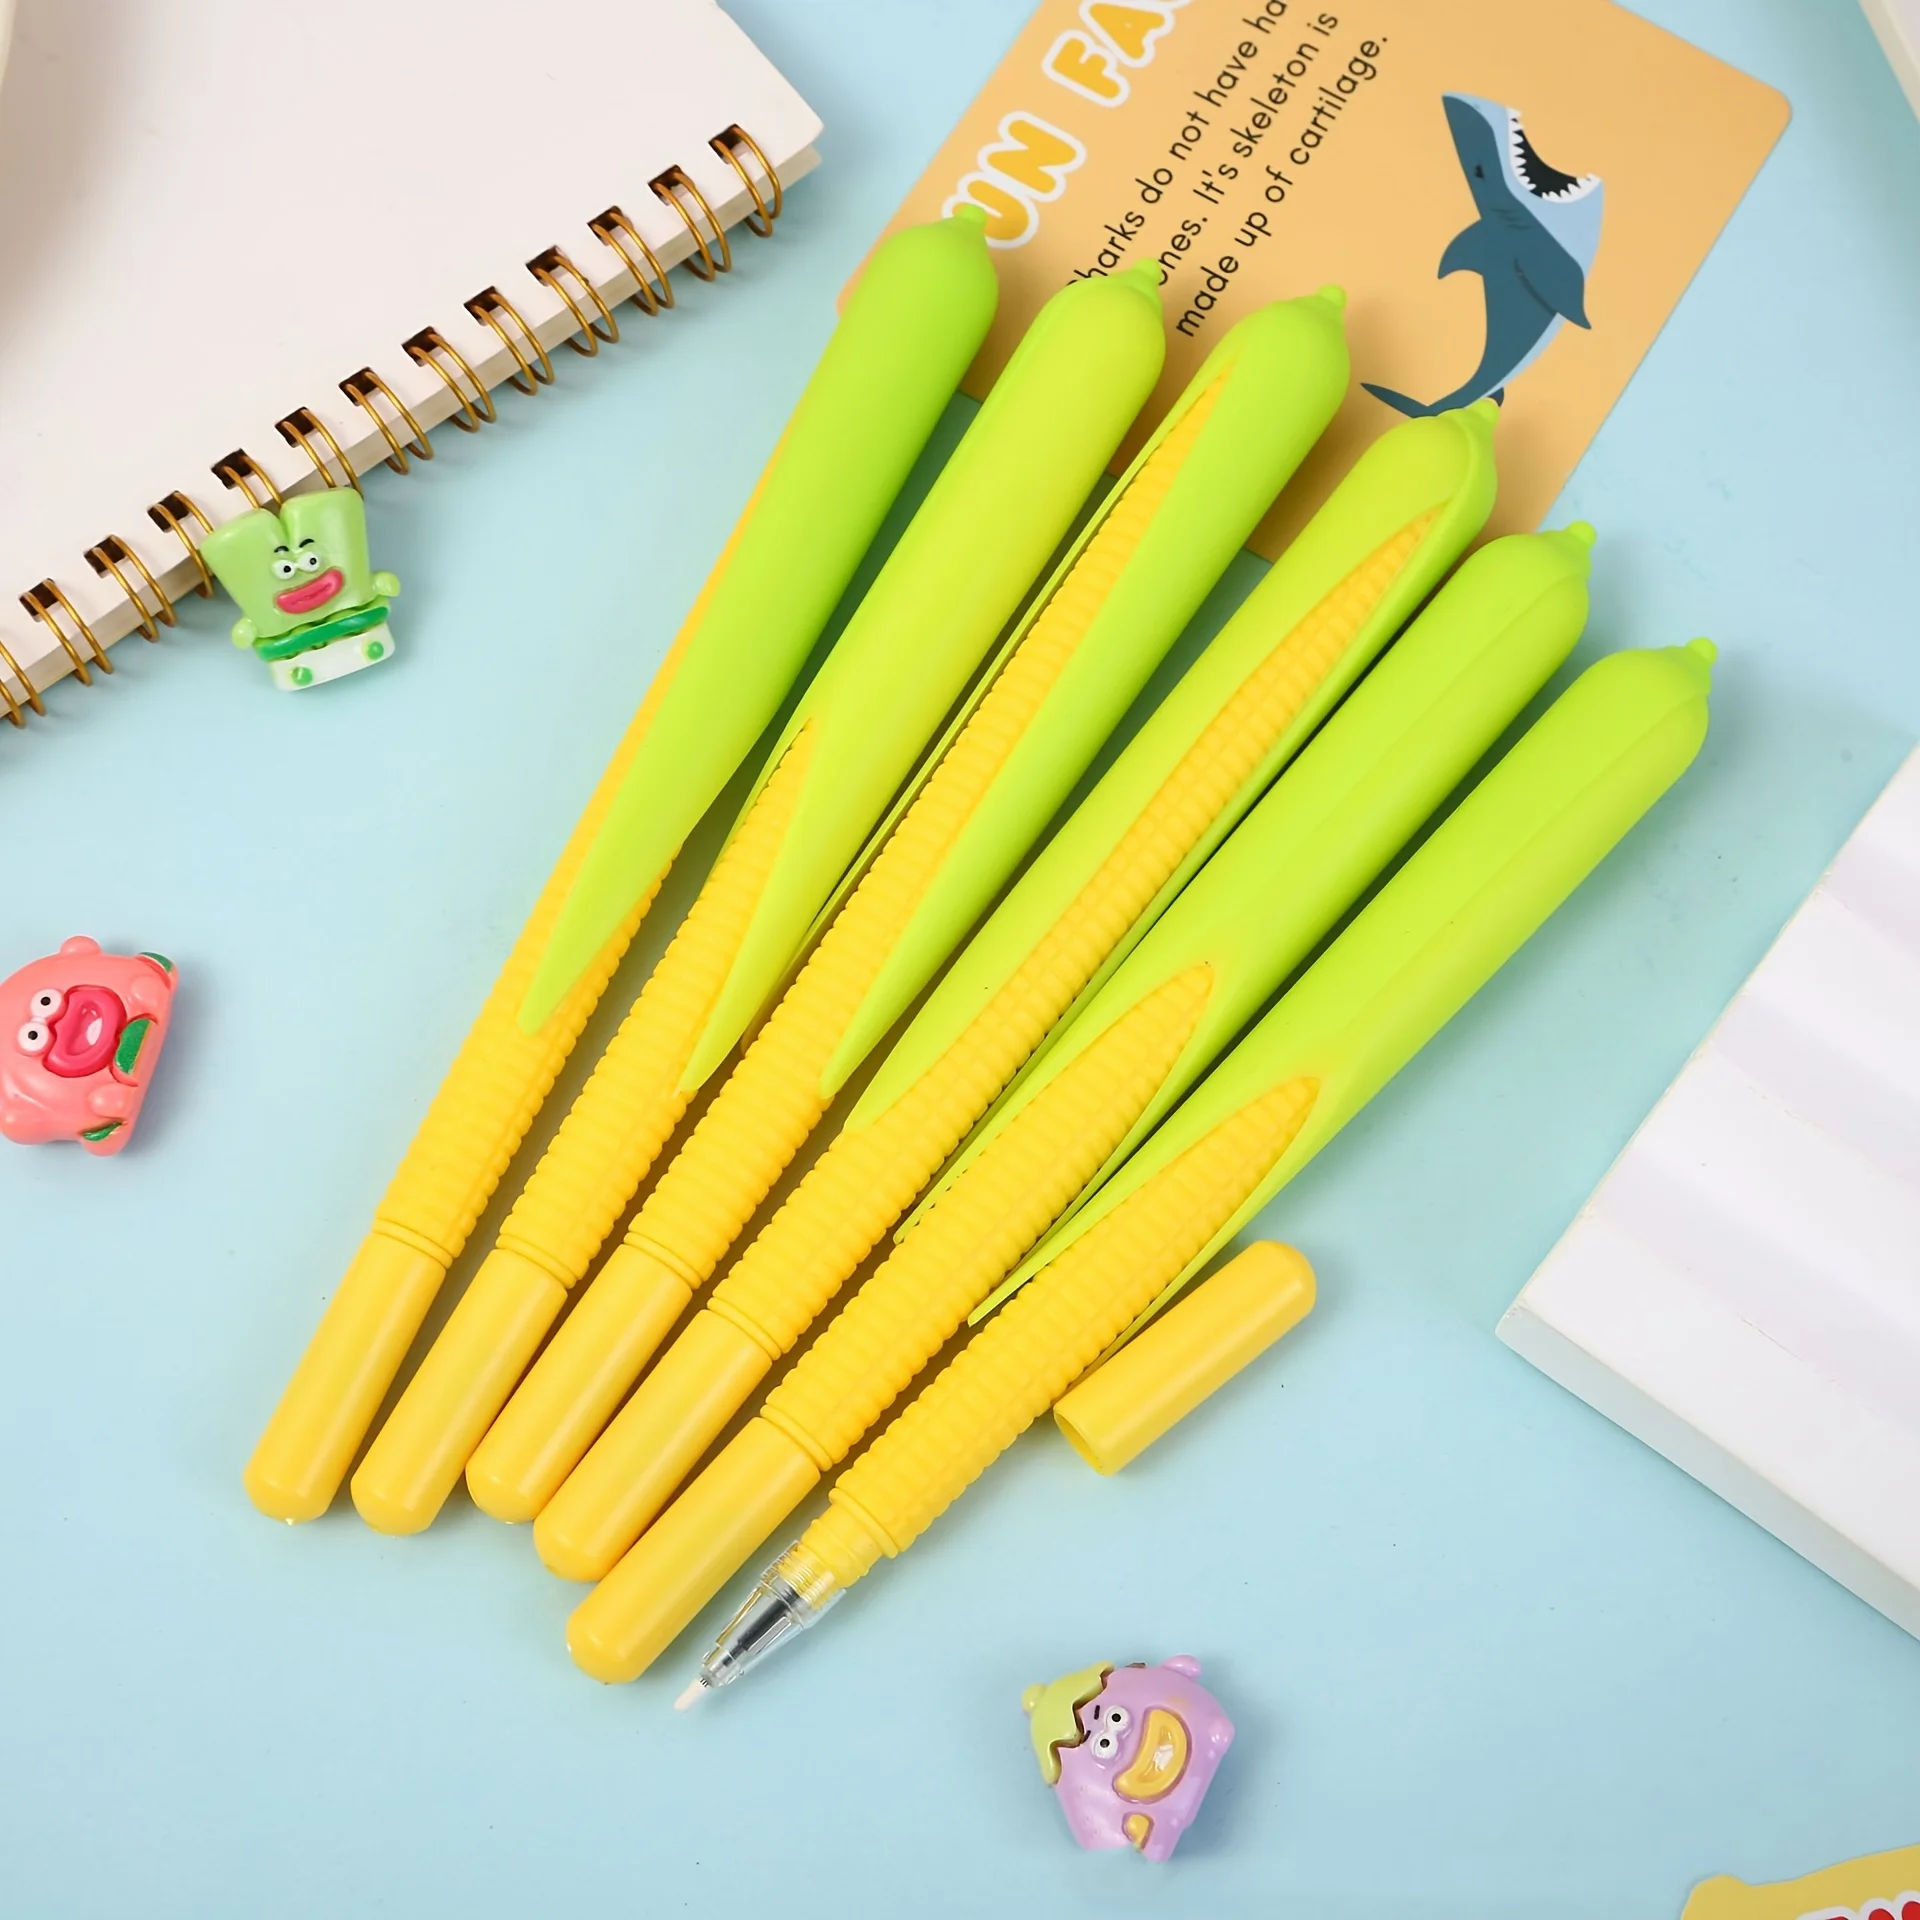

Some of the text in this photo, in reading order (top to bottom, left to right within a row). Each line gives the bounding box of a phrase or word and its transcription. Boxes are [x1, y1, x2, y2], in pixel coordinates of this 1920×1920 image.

[1041, 0, 1188, 107] FA
[1066, 211, 1145, 286] harks
[1134, 167, 1174, 204] do
[1168, 111, 1210, 161] not
[1193, 40, 1258, 108] have
[1193, 163, 1239, 204] It's
[1229, 42, 1320, 158] skeleton
[1306, 12, 1339, 37] is
[1176, 37, 1388, 337] made up of cartilage.
